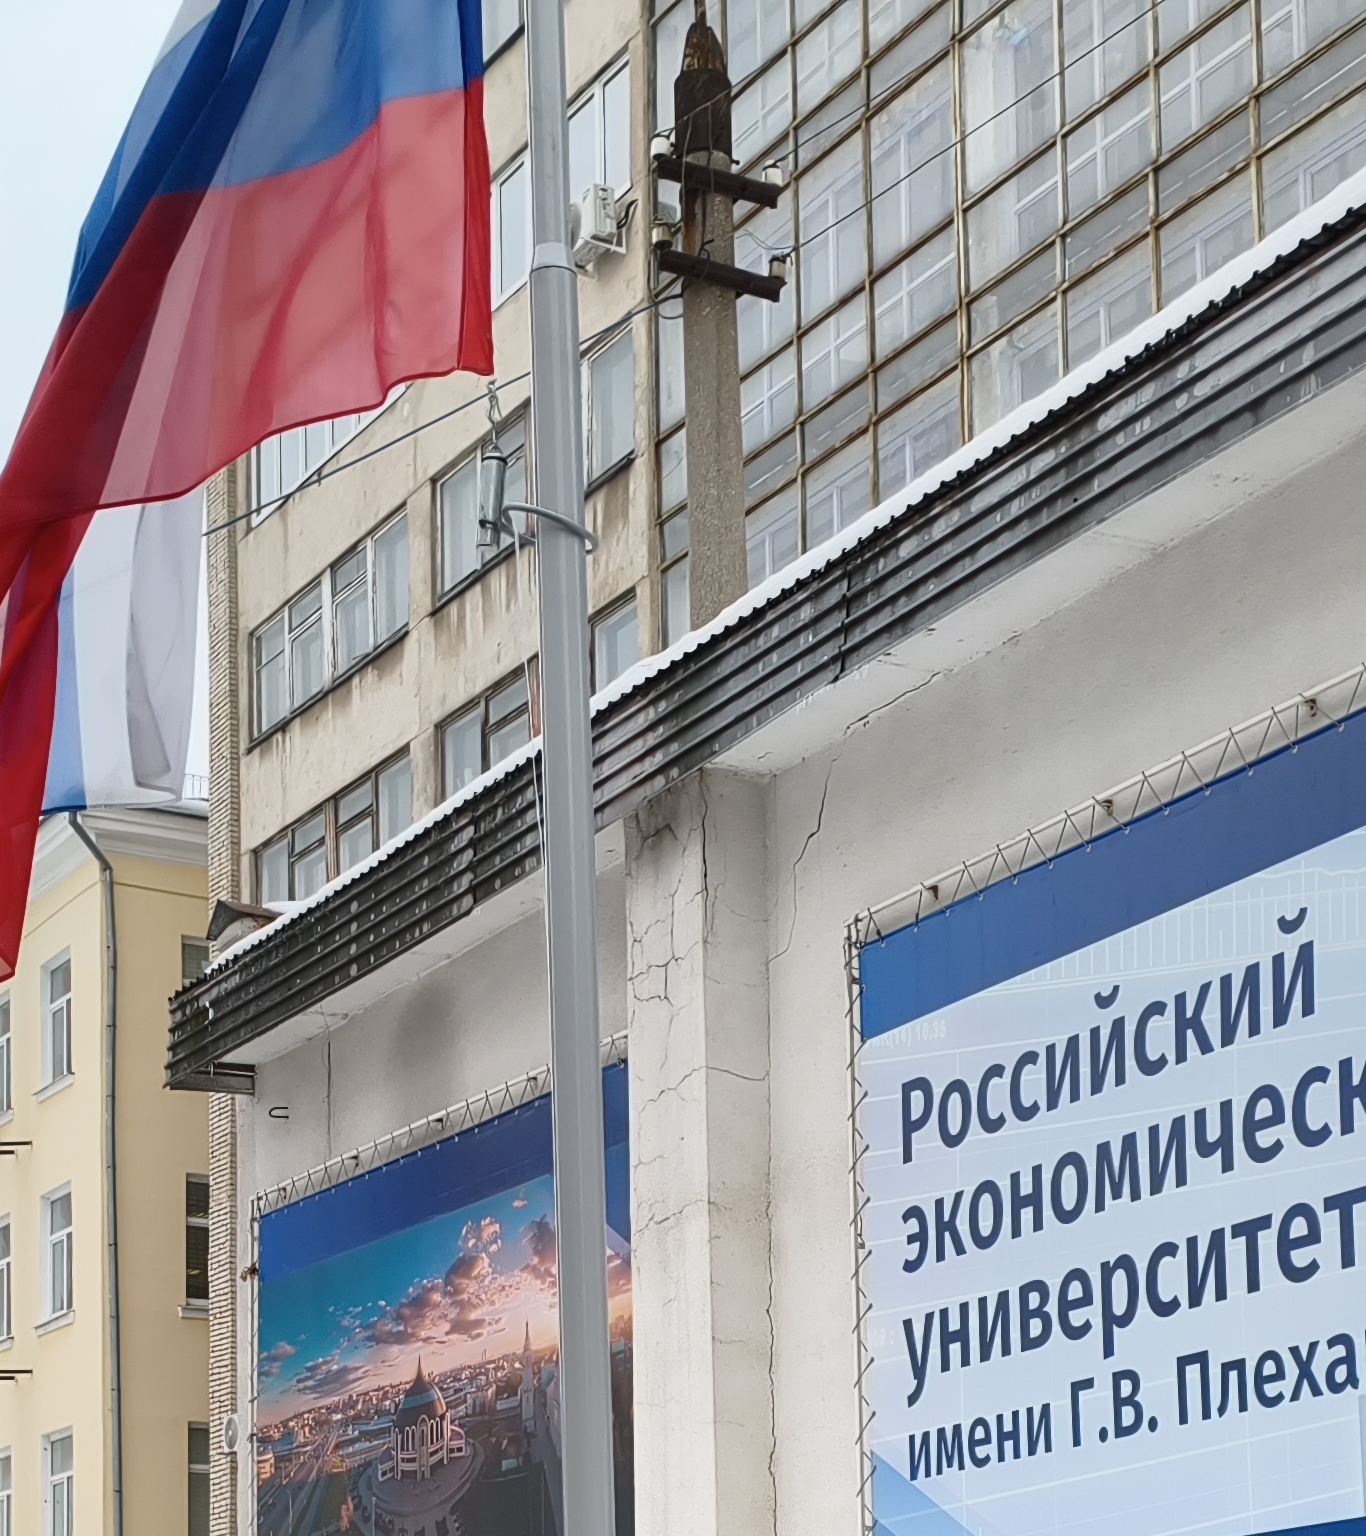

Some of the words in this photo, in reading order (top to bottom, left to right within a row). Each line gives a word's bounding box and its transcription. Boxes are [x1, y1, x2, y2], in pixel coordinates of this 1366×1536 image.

[900, 906, 1316, 1165] Российский
[908, 1402, 1053, 1482] имени
[1070, 1369, 1158, 1449] Г.В.
